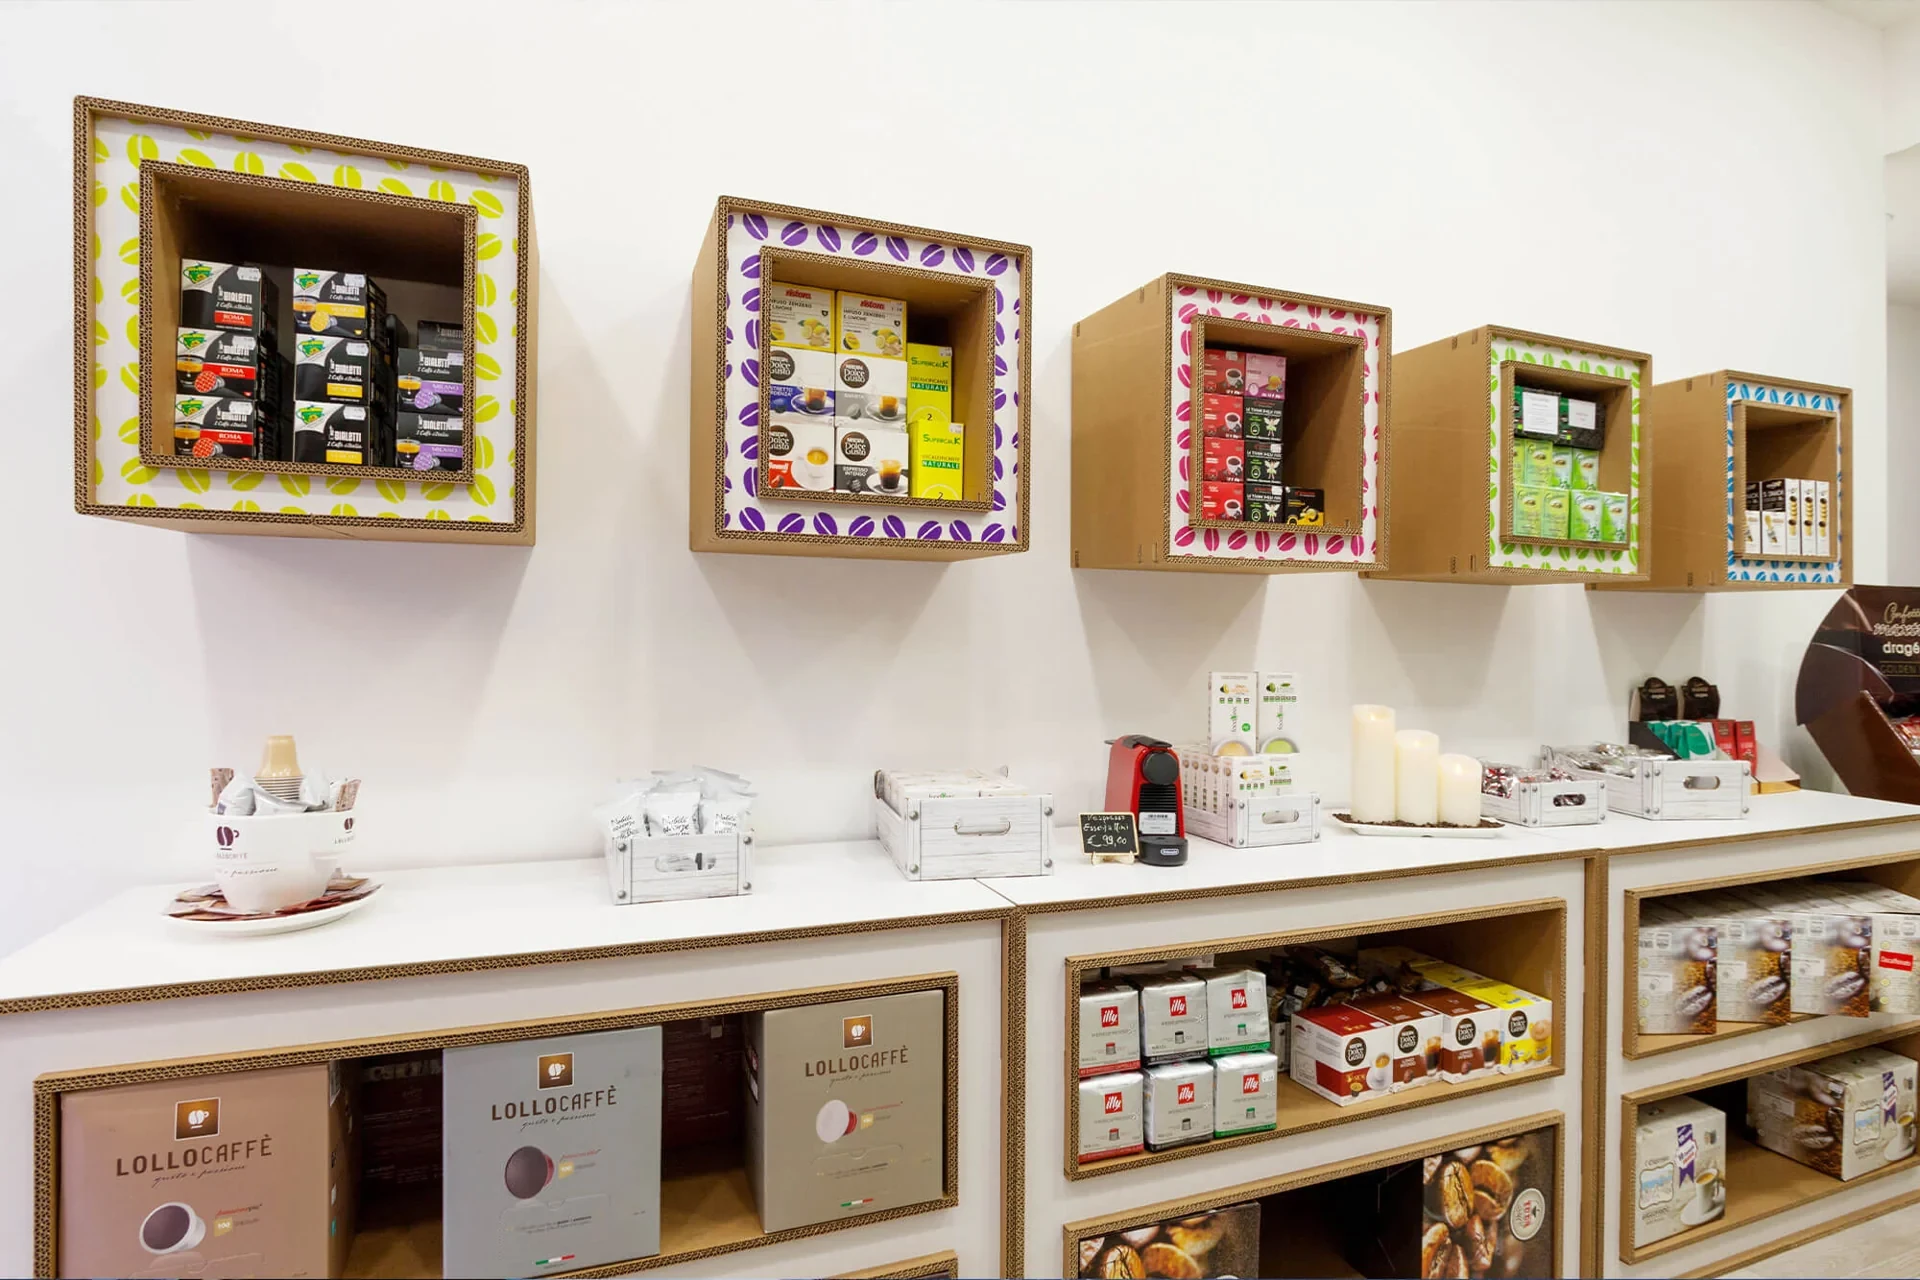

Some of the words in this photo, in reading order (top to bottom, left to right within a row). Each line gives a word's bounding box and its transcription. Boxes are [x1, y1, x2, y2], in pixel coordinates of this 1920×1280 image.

[223, 291, 253, 304] BIALETTI
[335, 284, 360, 296] BIALETTI
[223, 313, 245, 321] ROMA
[335, 363, 362, 375] BIALETTI
[927, 413, 933, 421] 2
[334, 430, 362, 442] BIALETTI
[1882, 641, 1920, 657] dragé
[1171, 999, 1186, 1014] illy
[1234, 992, 1246, 1006] illy
[1102, 1009, 1118, 1025] illy
[805, 1044, 909, 1077] LOLLOCAFFÈ
[1244, 1076, 1259, 1091] illy
[1179, 1086, 1194, 1101] illy
[491, 1084, 618, 1121] LOLLOCAFFÈ
[1105, 1095, 1121, 1111] illy
[556, 1112, 597, 1125] passione
[115, 1133, 273, 1177] LOLLOCAFFÈ
[197, 1163, 246, 1179] passione
